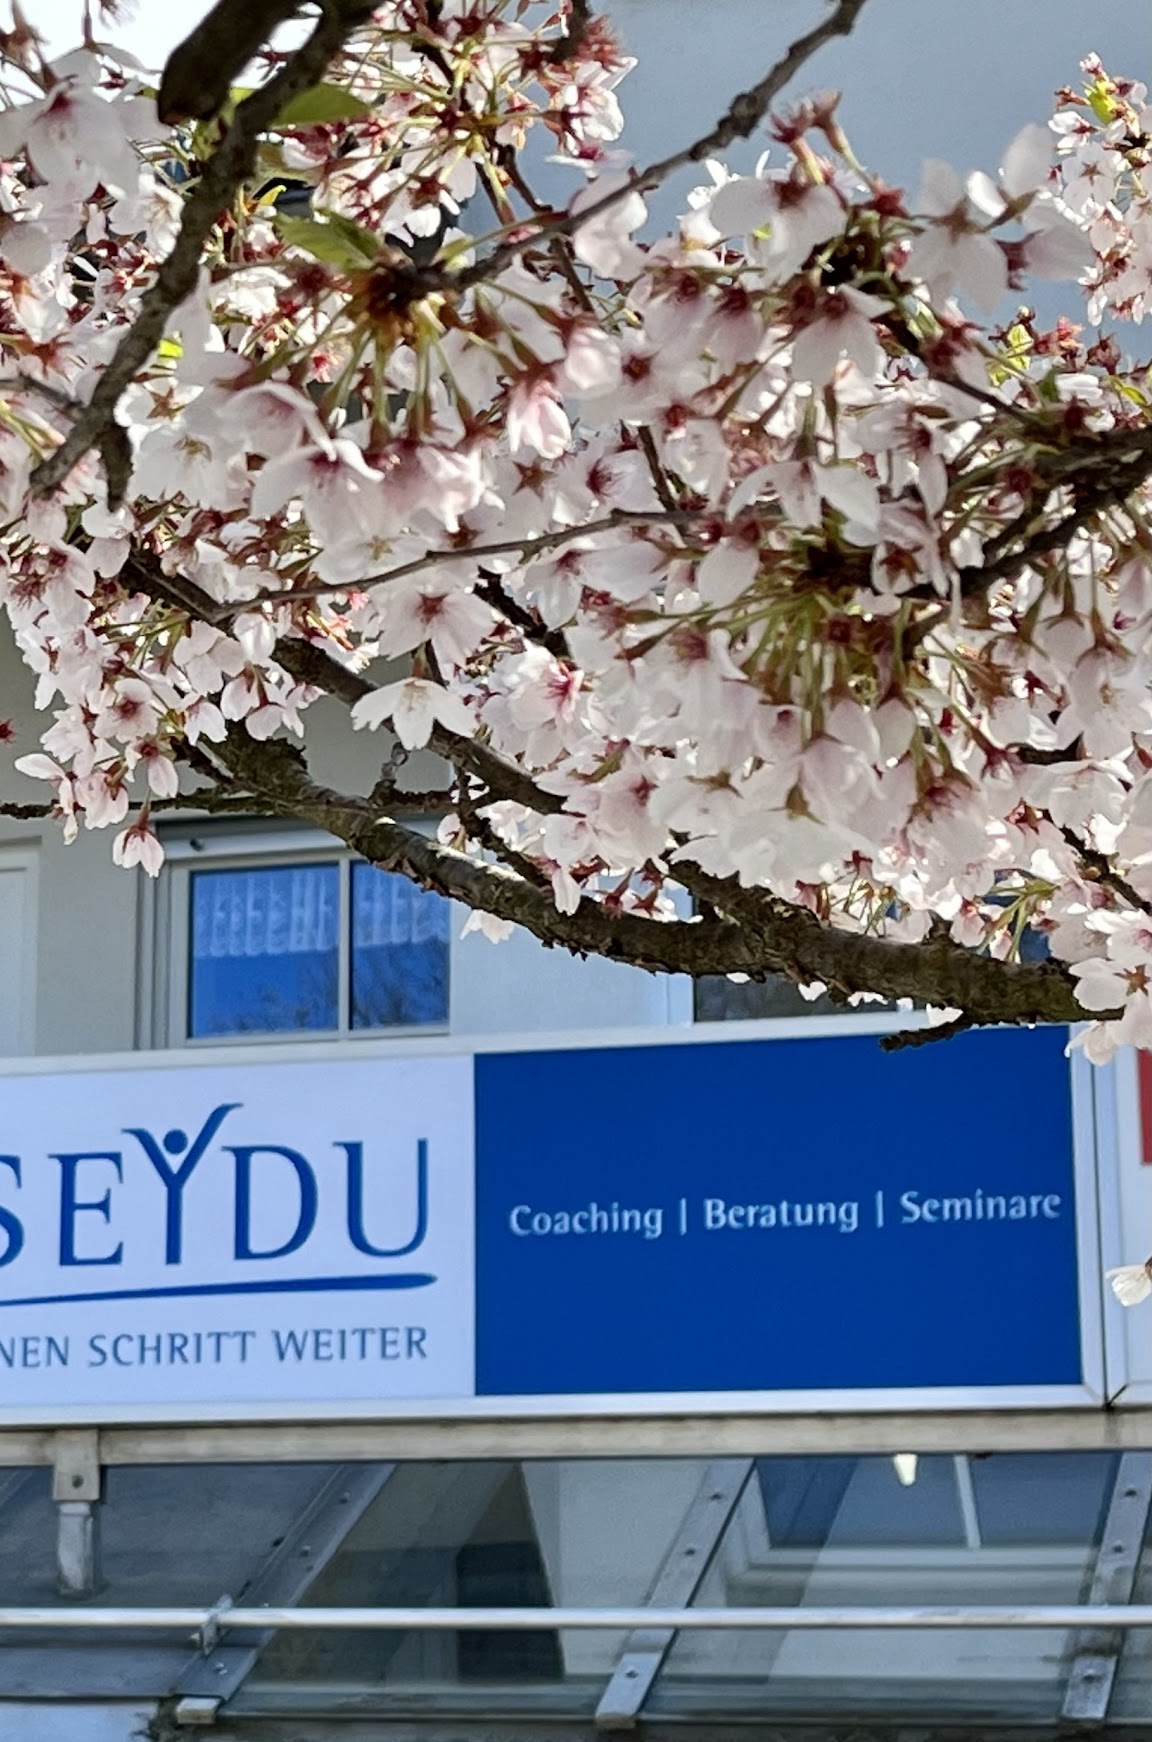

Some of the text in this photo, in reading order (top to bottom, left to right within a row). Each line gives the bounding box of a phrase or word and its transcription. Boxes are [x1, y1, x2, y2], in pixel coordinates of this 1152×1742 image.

[510, 1202, 663, 1238] Coaching
[704, 1198, 859, 1232] Beratung
[900, 1188, 1061, 1223] Seminare
[88, 1330, 256, 1368] SCHRITT
[271, 1326, 427, 1363] WEITER
